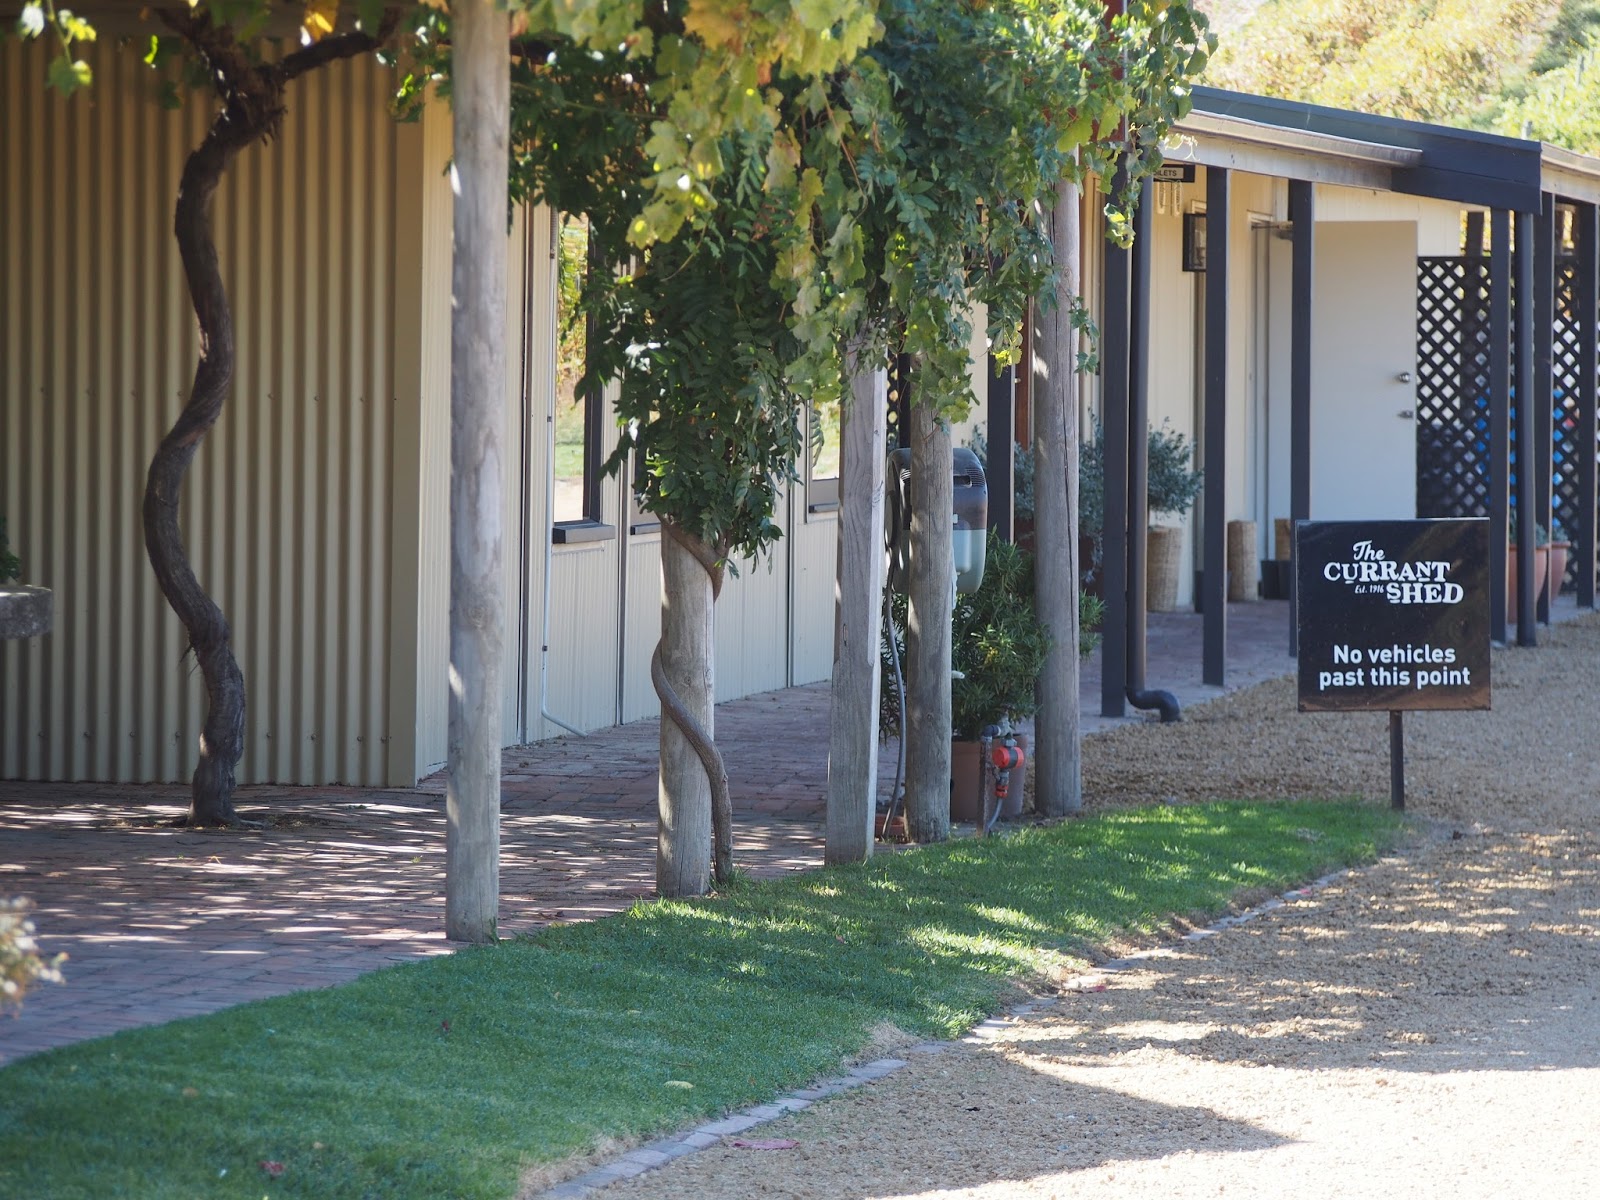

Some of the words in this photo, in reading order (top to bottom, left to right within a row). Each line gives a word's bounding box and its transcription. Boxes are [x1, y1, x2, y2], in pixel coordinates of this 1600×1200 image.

[1353, 540, 1386, 561] The
[1324, 561, 1451, 584] CURRANT
[1355, 584, 1368, 594] Est.
[1370, 584, 1385, 594] 1916
[1386, 582, 1464, 604] SHED
[1333, 644, 1363, 664] No
[1368, 644, 1456, 664] vehicles
[1319, 667, 1365, 691] past
[1370, 666, 1411, 686] this
[1416, 666, 1471, 690] point
